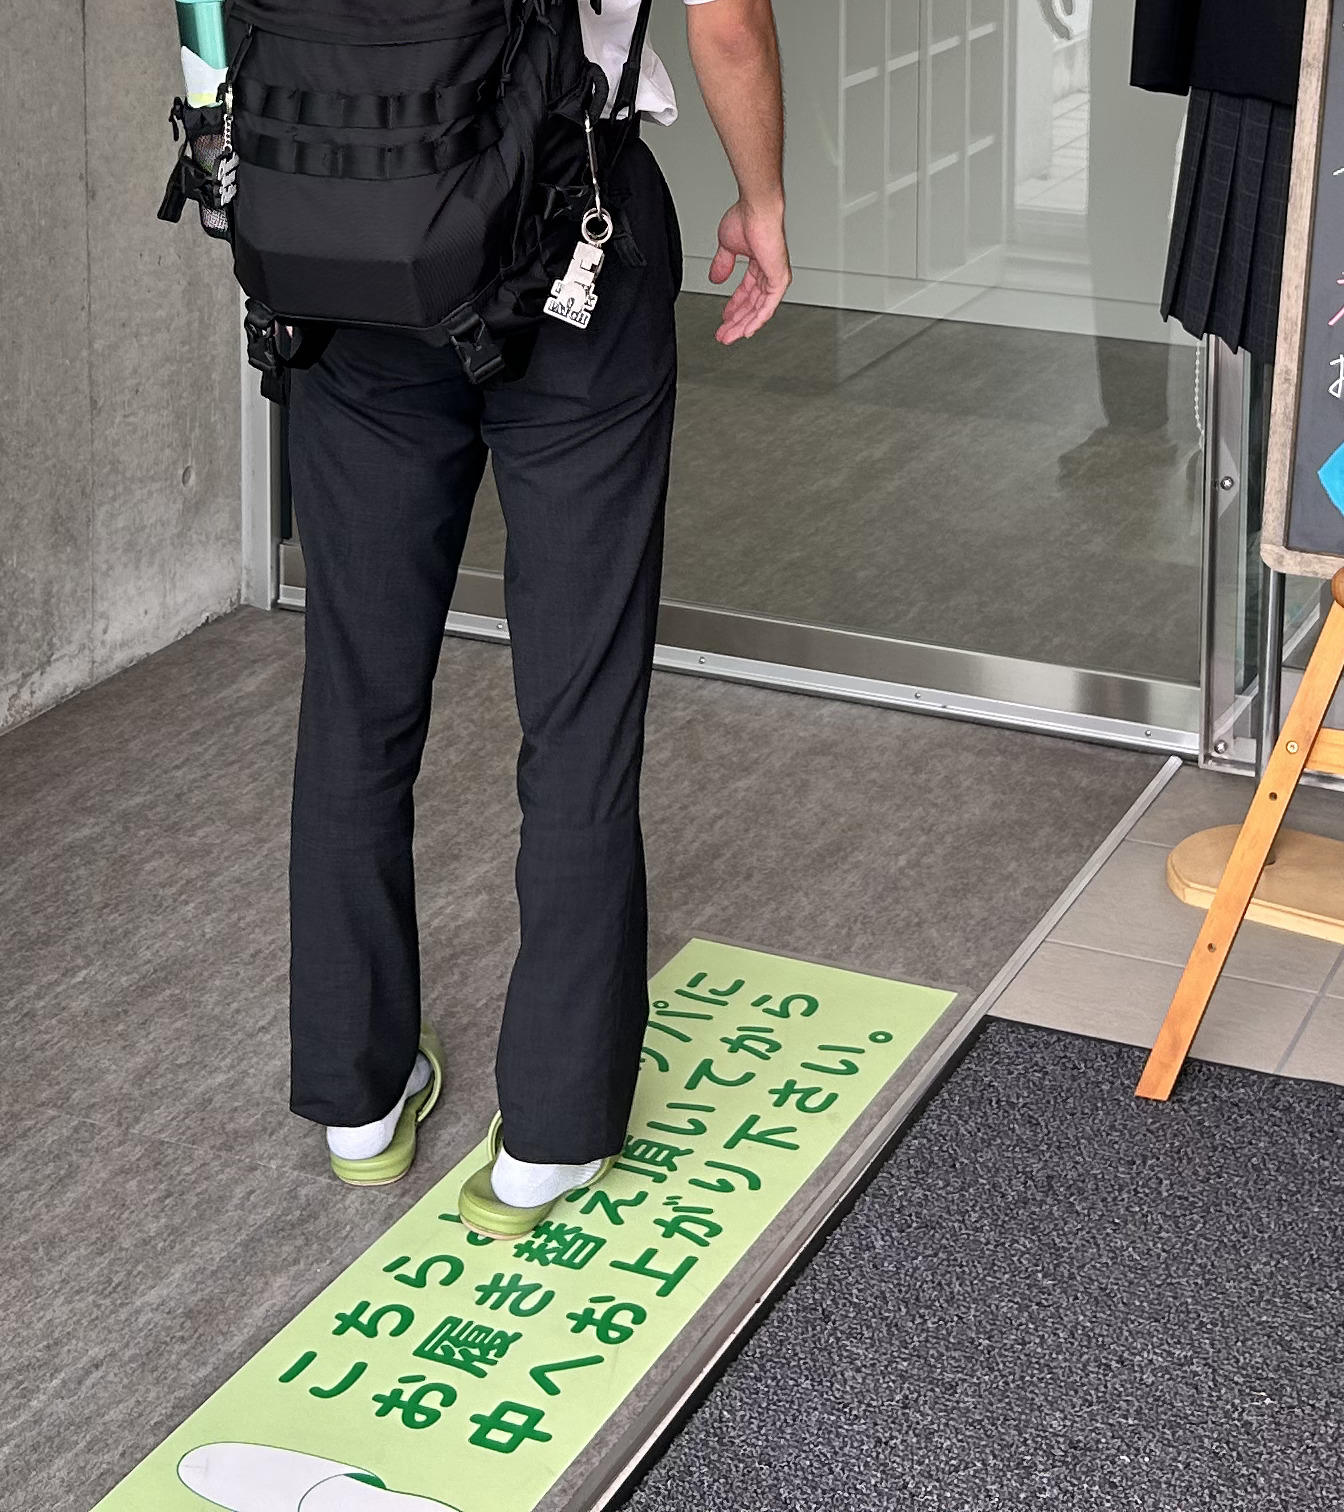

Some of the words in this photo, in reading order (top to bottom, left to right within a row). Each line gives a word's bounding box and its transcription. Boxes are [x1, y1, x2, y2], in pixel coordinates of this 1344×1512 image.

[468, 1029, 894, 1455] 中へお上がり下さい。
